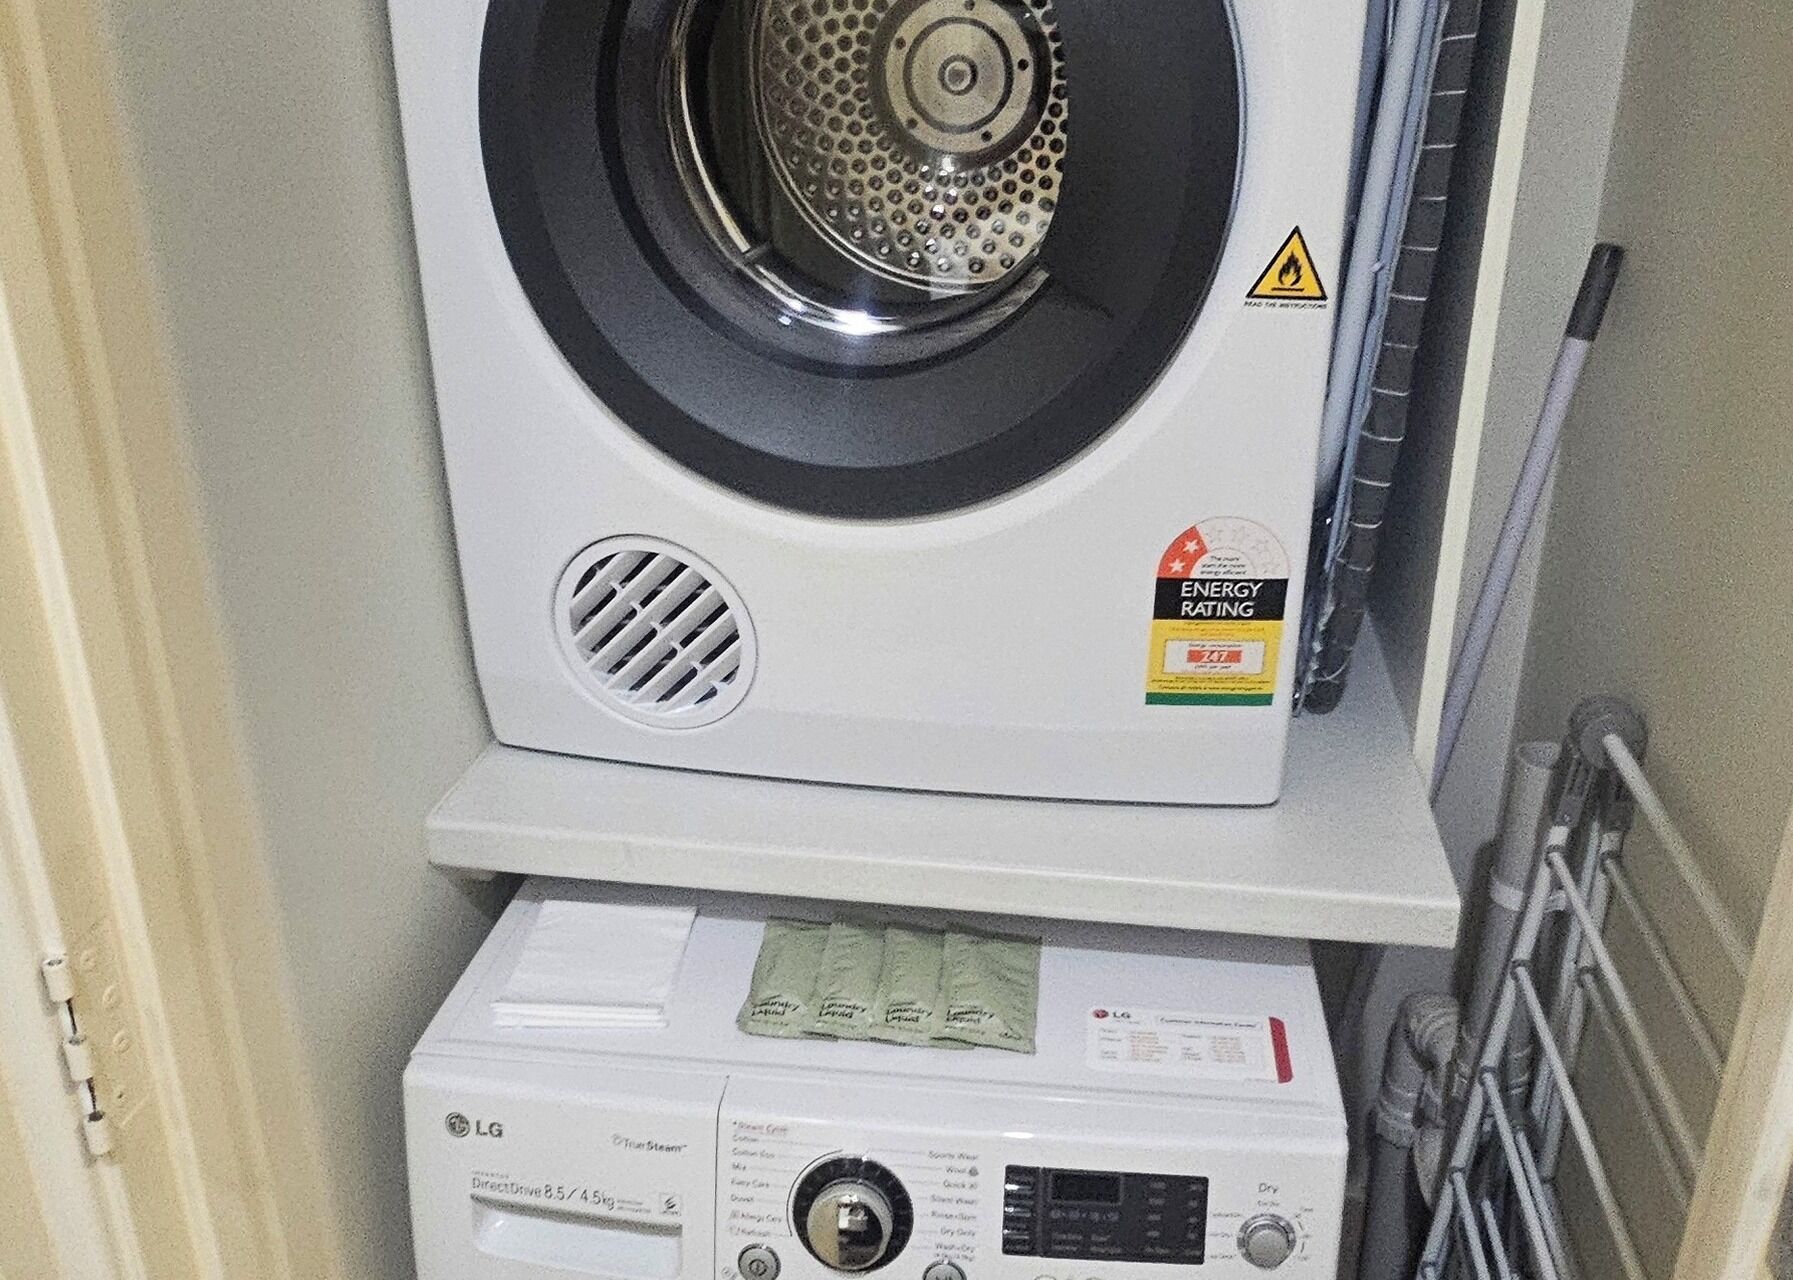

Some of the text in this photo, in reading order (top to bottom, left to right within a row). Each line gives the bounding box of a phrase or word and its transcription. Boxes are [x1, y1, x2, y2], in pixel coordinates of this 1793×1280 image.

[1181, 581, 1264, 598] ENERGY
[1181, 601, 1256, 618] RATING
[1201, 651, 1228, 663] 247
[475, 1119, 504, 1138] LG
[1258, 1182, 1279, 1194] Dry
[544, 1184, 566, 1201] 8.5
[580, 1189, 616, 1211] 4.5kg
